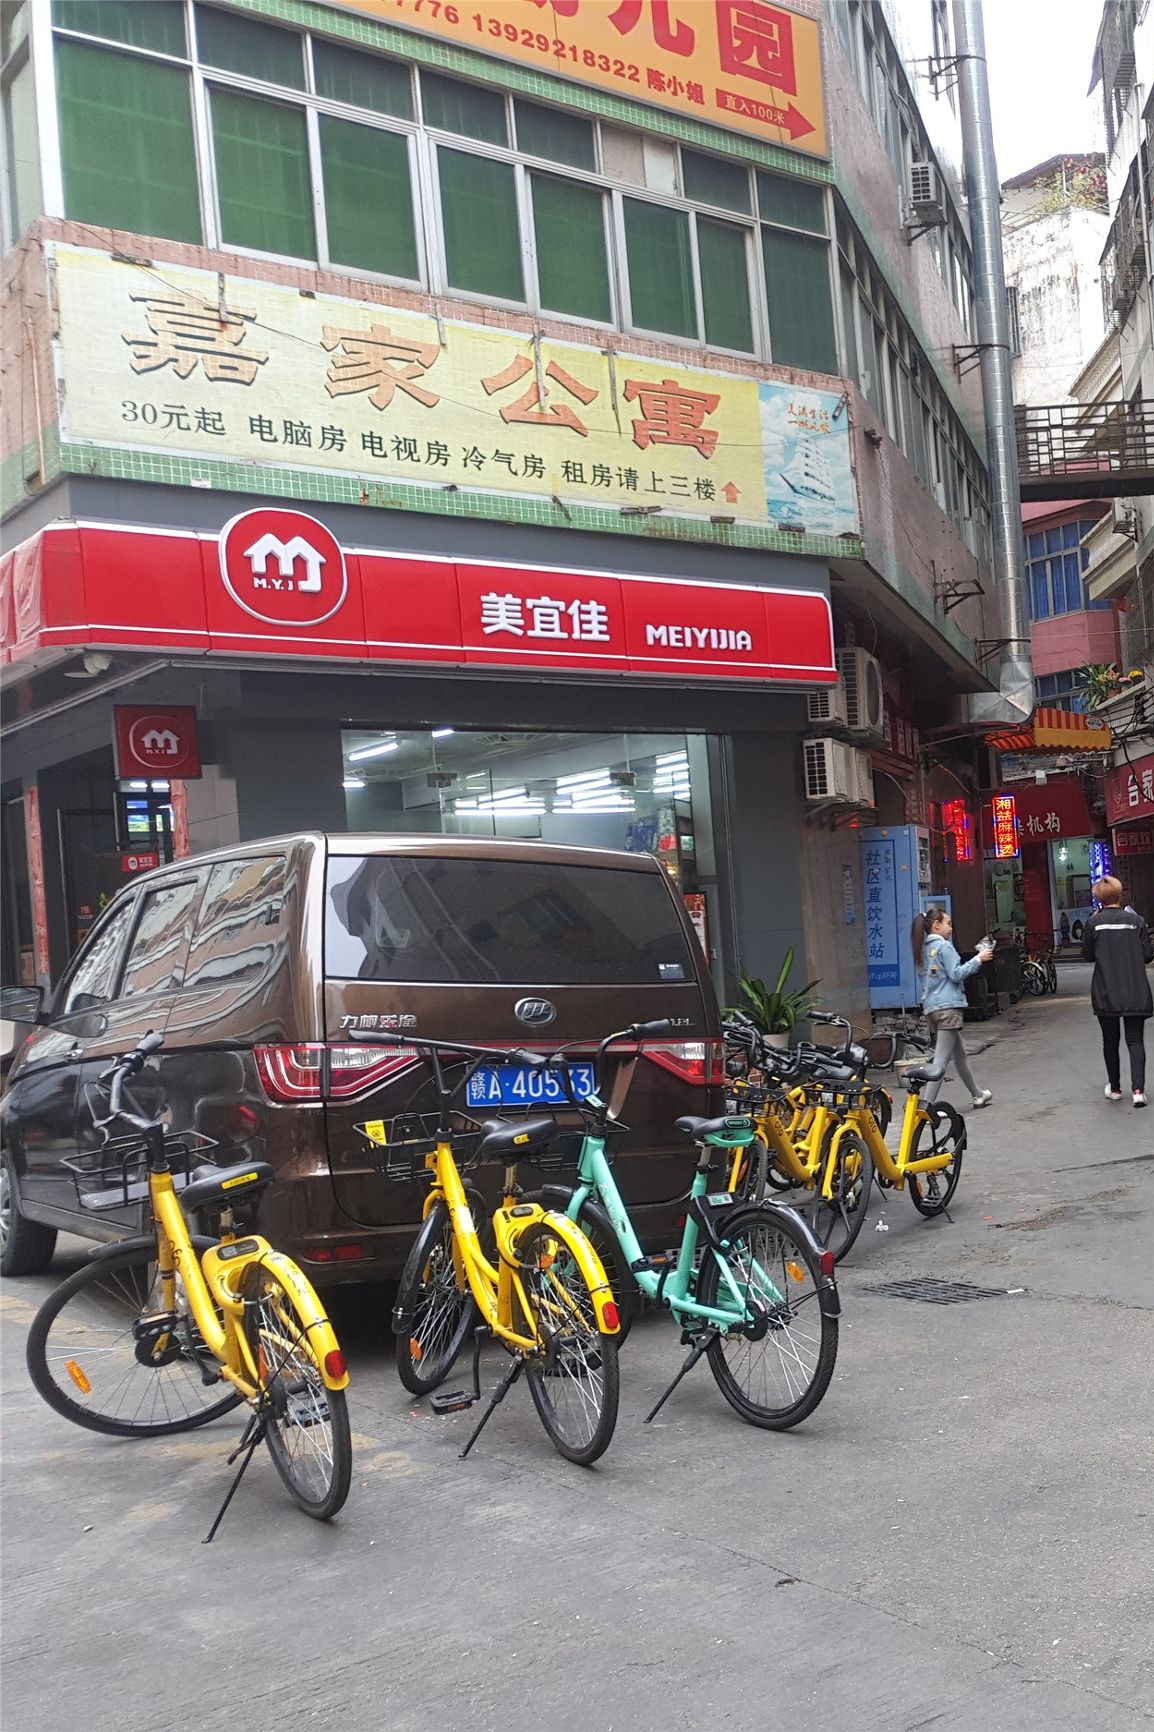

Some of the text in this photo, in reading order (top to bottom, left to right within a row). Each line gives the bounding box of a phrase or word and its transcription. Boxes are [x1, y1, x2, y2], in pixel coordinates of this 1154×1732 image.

[472, 14, 640, 83] 13929218322
[646, 67, 705, 105] 陈小姐
[534, 0, 797, 97] 儿园
[725, 94, 785, 125] 直入100米
[121, 287, 721, 460] 嘉家公寓
[121, 399, 716, 502] 30元起 电脑房 电视房 冷气房 租房请上三楼
[479, 592, 611, 642] 美宜佳
[645, 624, 752, 651] MEIYIJIA
[1017, 811, 1061, 837] 机构
[865, 849, 885, 959] 社区直饮水站
